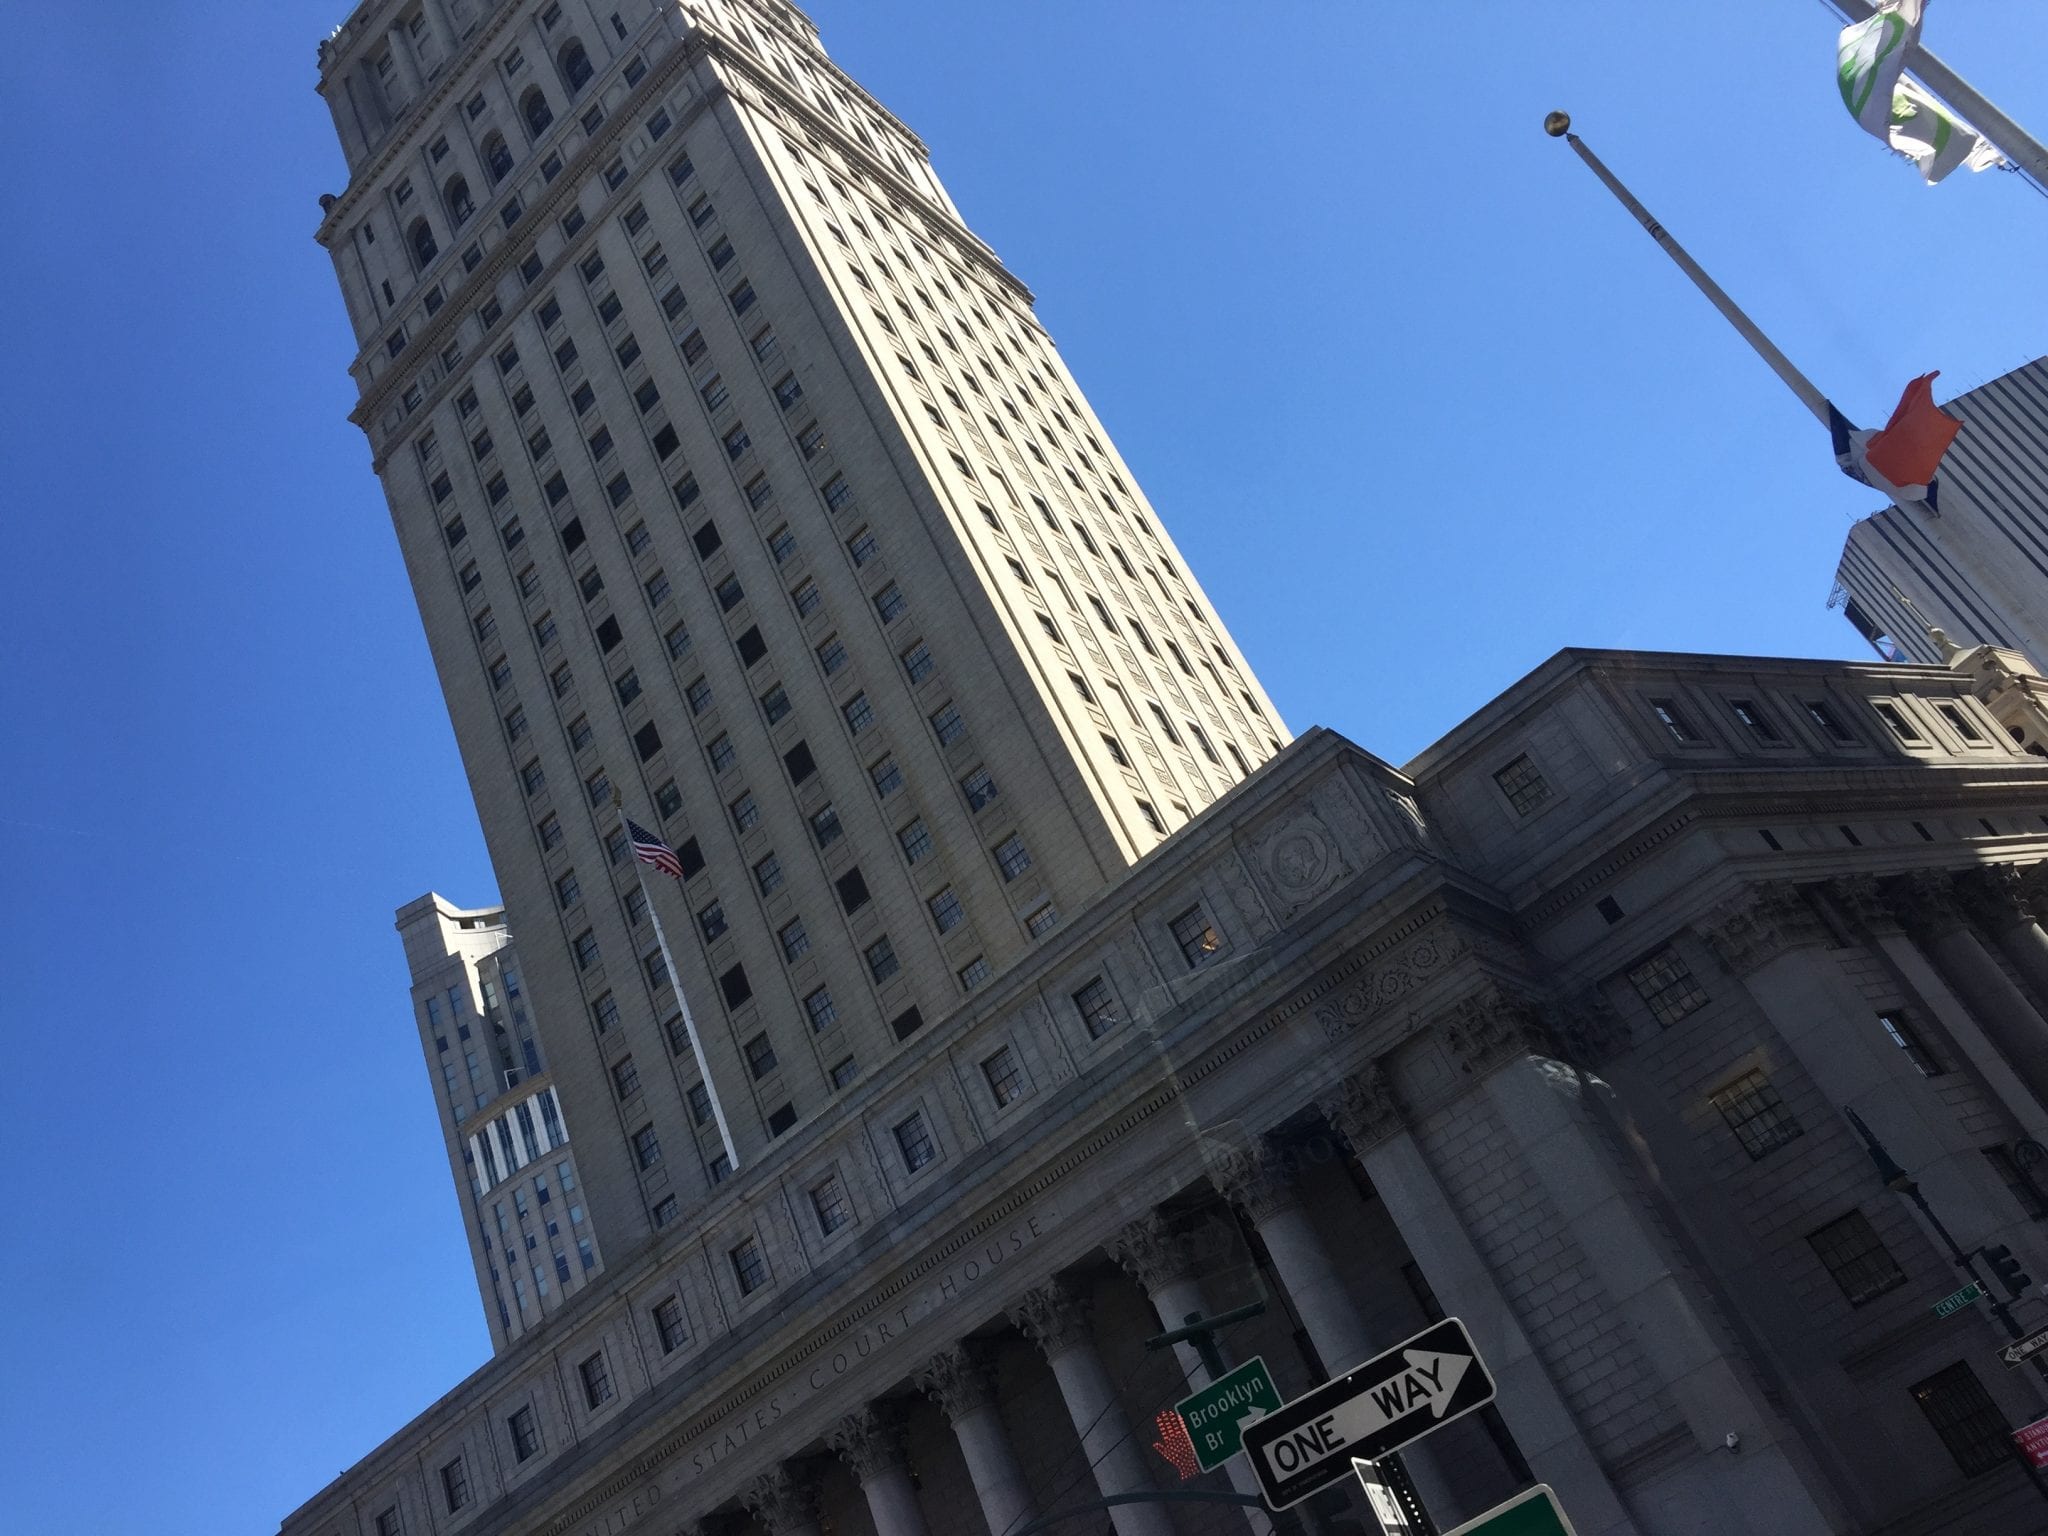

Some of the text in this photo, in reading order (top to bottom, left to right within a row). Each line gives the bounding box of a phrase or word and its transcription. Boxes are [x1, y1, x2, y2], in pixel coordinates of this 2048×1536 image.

[1936, 1293, 1969, 1316] CENTRE
[693, 1398, 782, 1475] STATES
[810, 1305, 909, 1390] COURT
[940, 1216, 1042, 1300] HOUSE
[2008, 1333, 2048, 1360] ONE WAY
[1189, 1377, 1264, 1429] Brooklyn
[1274, 1357, 1443, 1472] ONE WAY
[1205, 1430, 1224, 1451] Br
